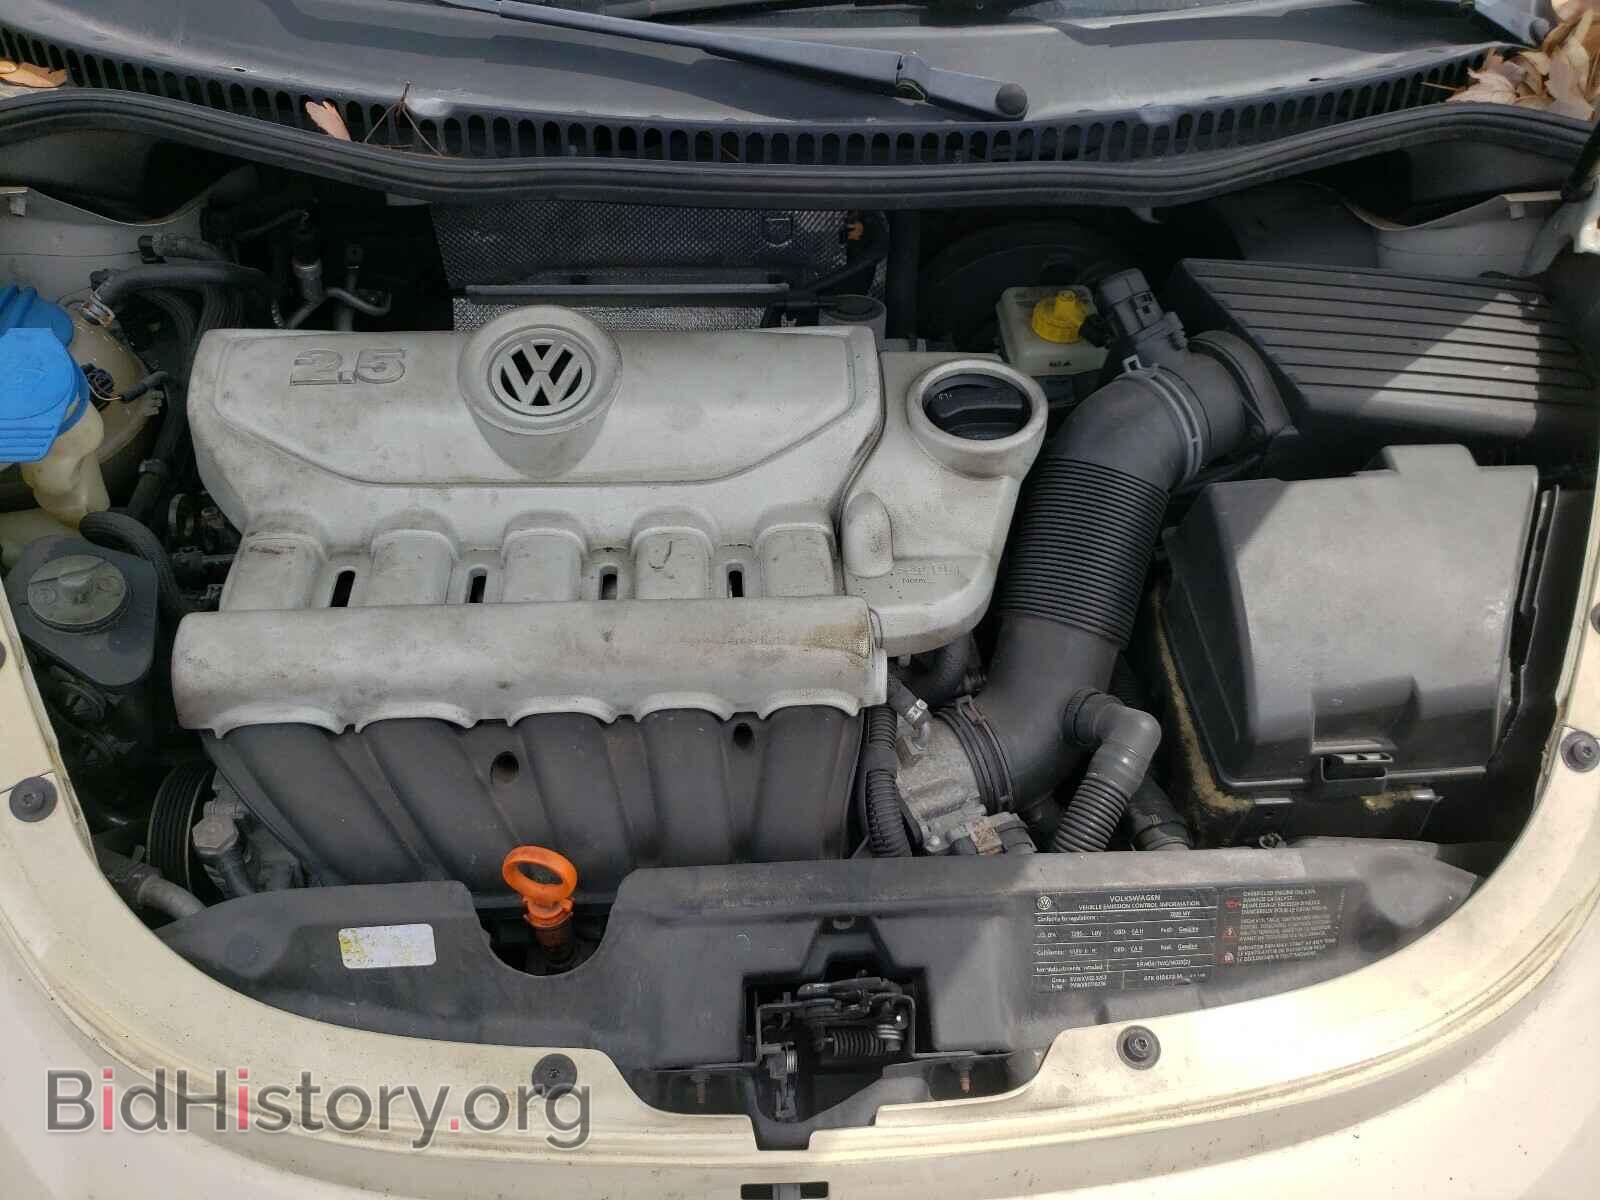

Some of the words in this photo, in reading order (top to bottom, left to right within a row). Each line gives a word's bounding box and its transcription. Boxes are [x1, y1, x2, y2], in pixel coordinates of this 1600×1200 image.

[289, 347, 408, 386] 2.5
[1109, 895, 1161, 903] VOLKSWAGEN
[1159, 900, 1201, 908] INFORMATION
